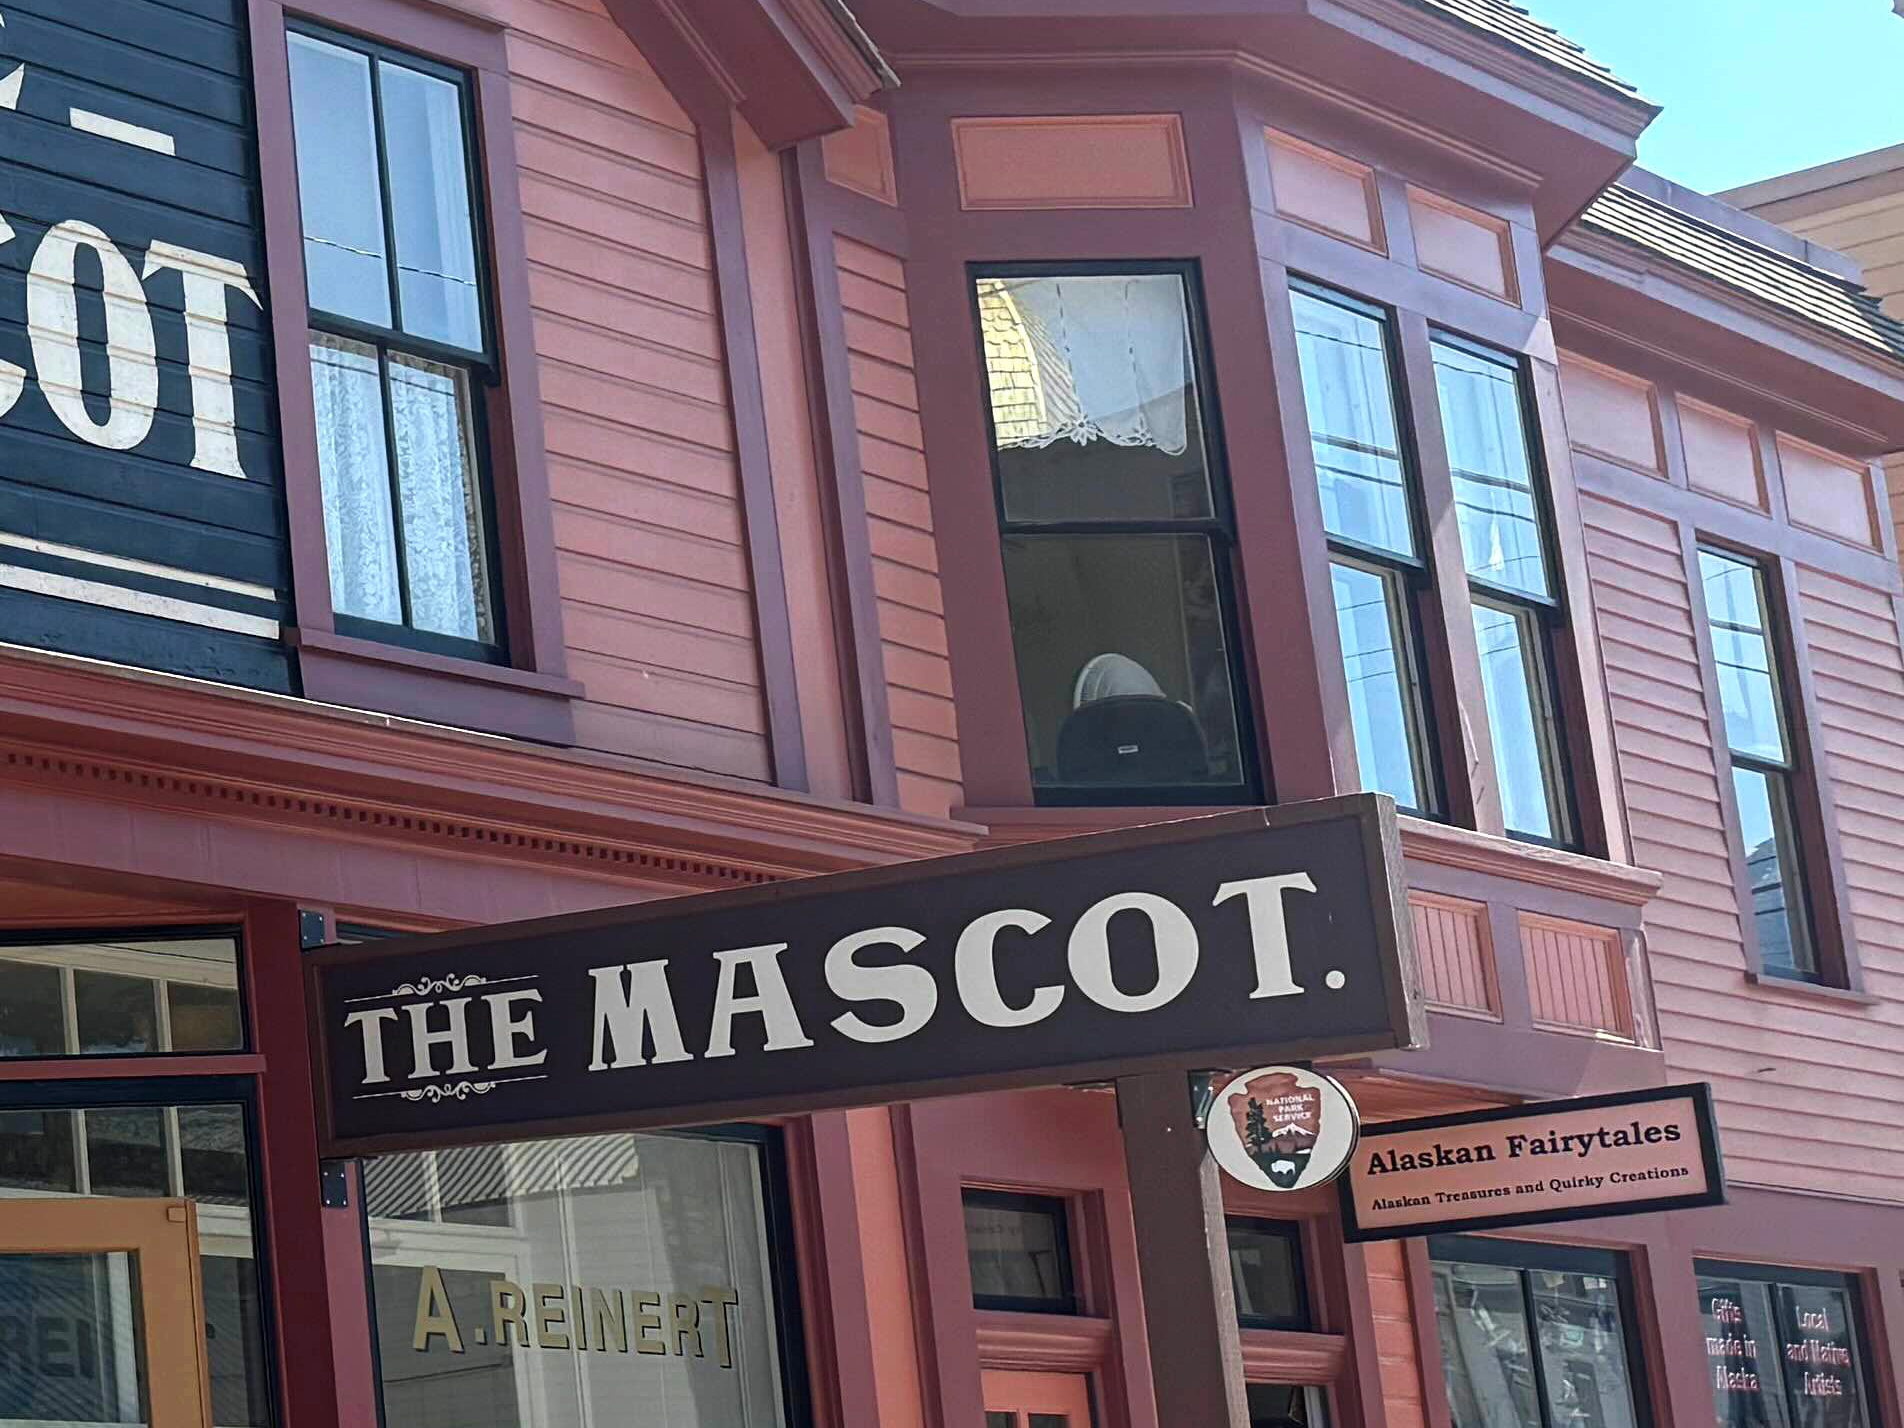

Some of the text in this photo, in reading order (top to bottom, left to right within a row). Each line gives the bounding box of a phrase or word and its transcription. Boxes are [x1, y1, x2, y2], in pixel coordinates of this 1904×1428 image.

[344, 870, 1347, 1084] THE MASCOT.
[1266, 1094, 1315, 1105] NATIONAL
[1278, 1104, 1304, 1113] PARK
[1272, 1112, 1312, 1122] SERVICE
[1367, 1121, 1681, 1175] Alaskan Fairytales
[1372, 1167, 1689, 1211] Alaskan Treasures and Quirky Creations
[490, 1280, 738, 1368] REINERT
[1796, 1306, 1829, 1331] Local
[1706, 1333, 1756, 1357] made in
[1787, 1340, 1850, 1366] and Native
[1716, 1366, 1758, 1390] Alaska
